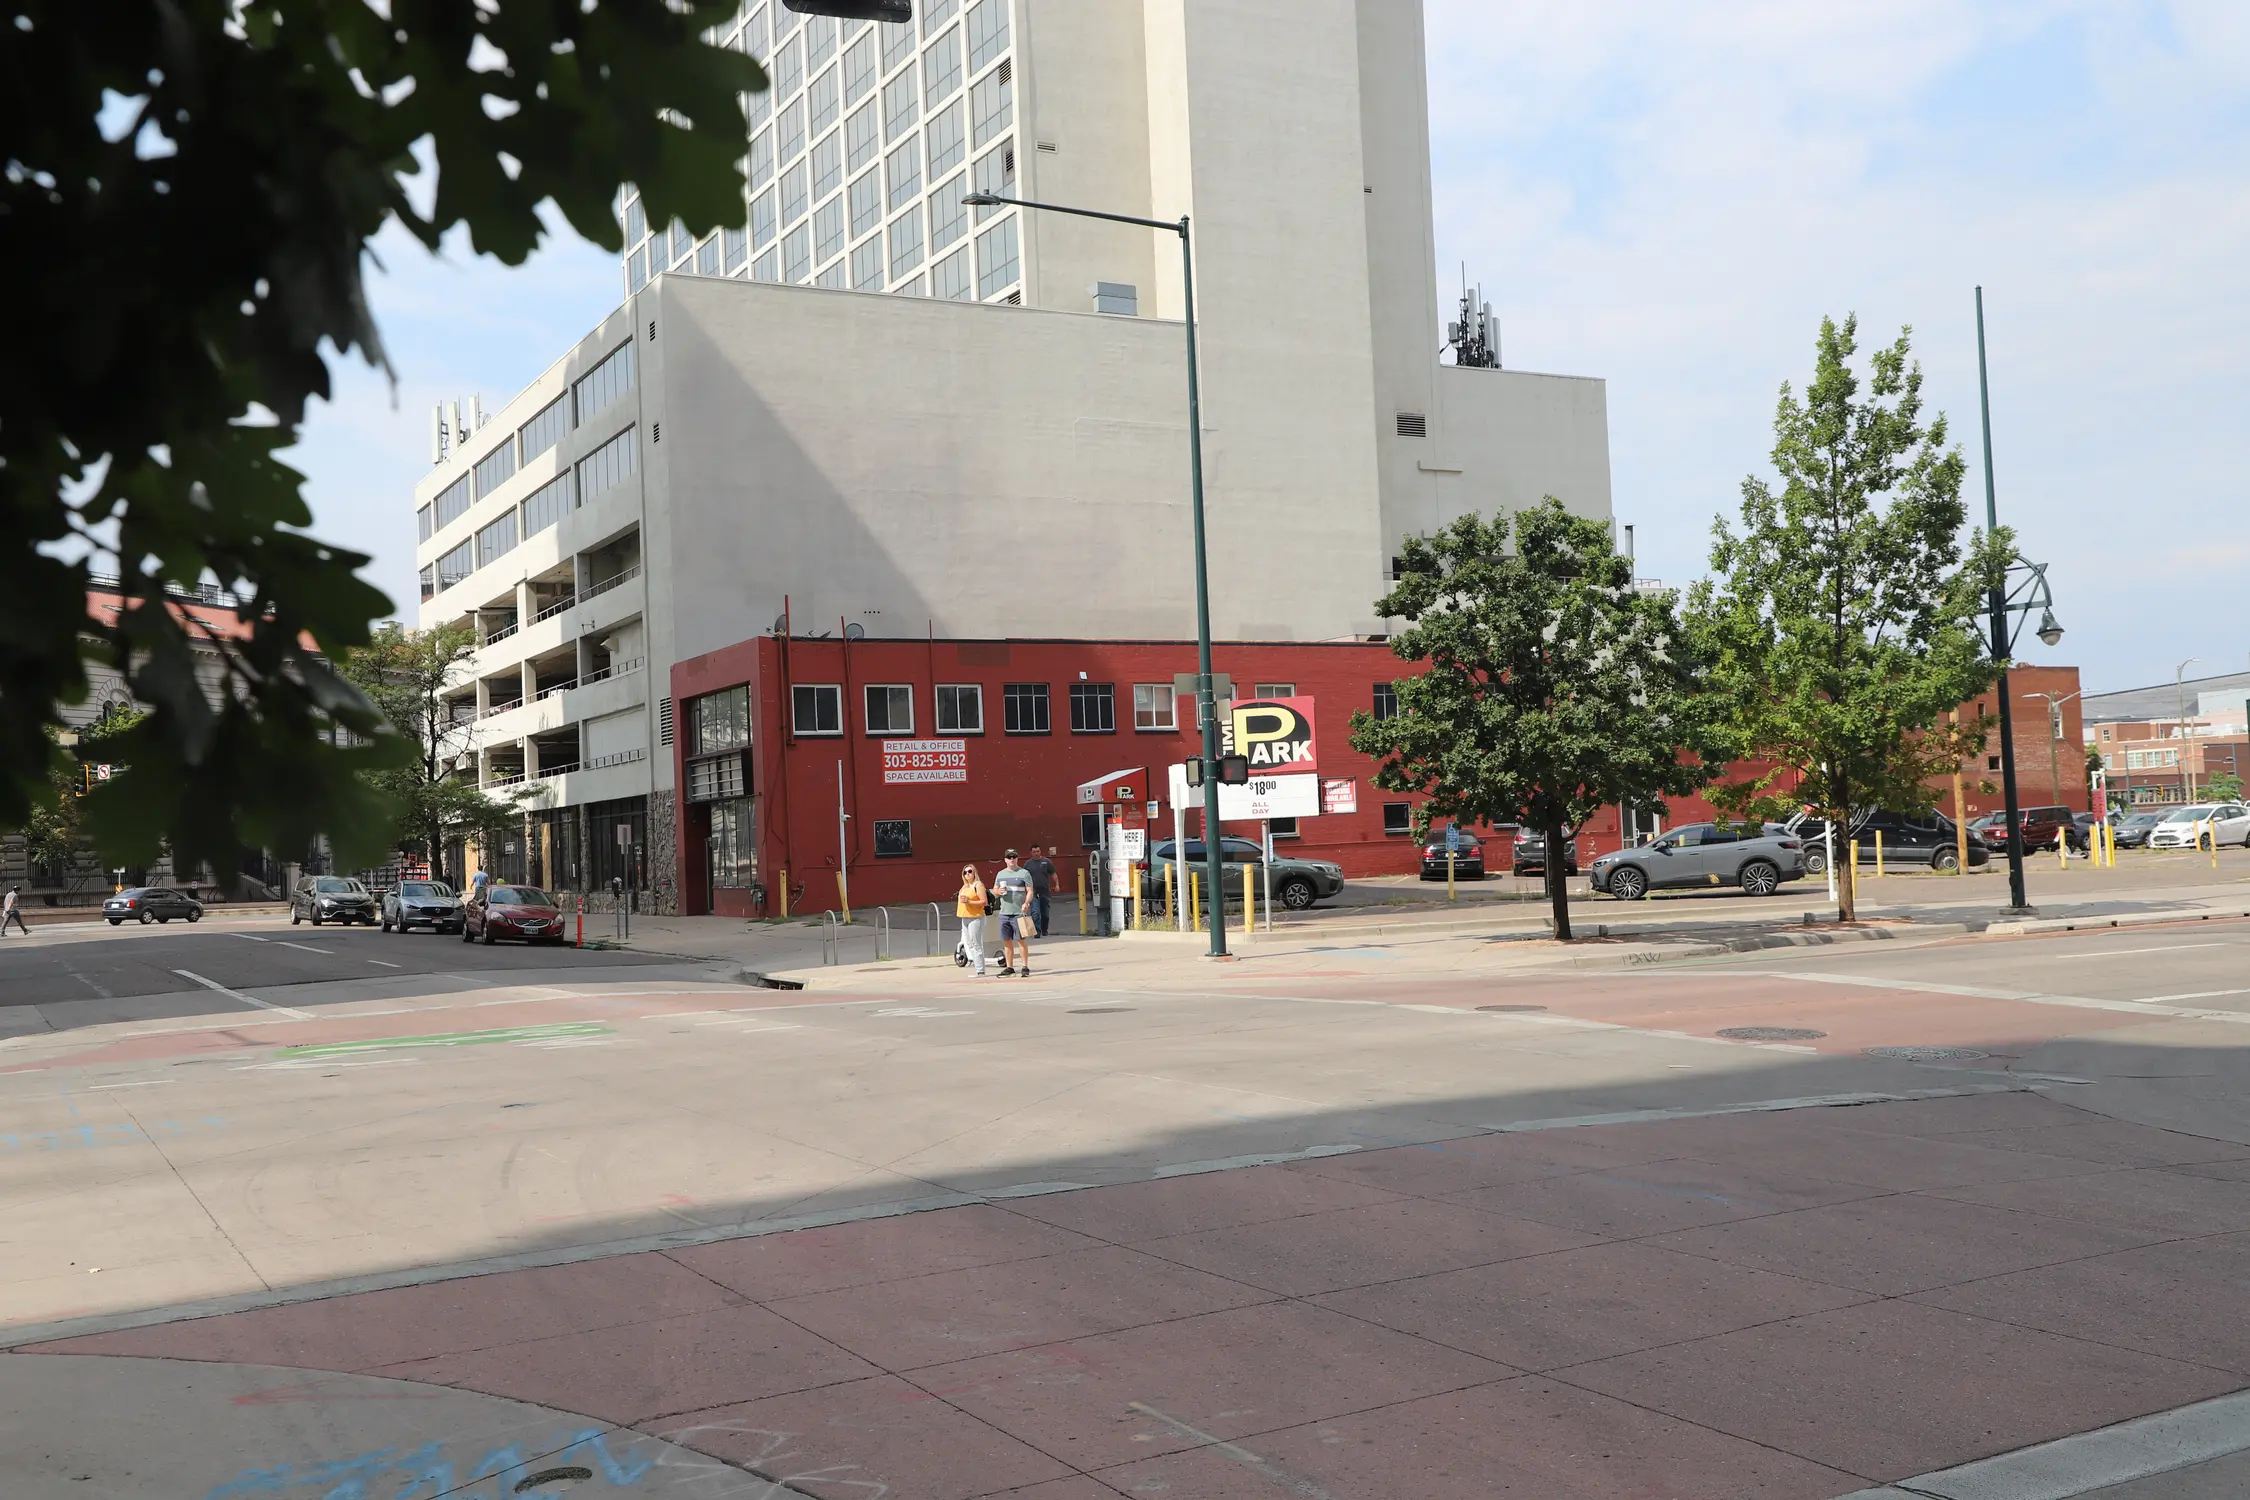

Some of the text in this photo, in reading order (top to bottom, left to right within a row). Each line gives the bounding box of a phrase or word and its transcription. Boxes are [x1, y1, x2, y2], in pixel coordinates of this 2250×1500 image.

[886, 742, 963, 751] RETAIL & OFFICE
[884, 753, 967, 769] 303-825-9192
[886, 771, 966, 781] SPACE AVAILABLE
